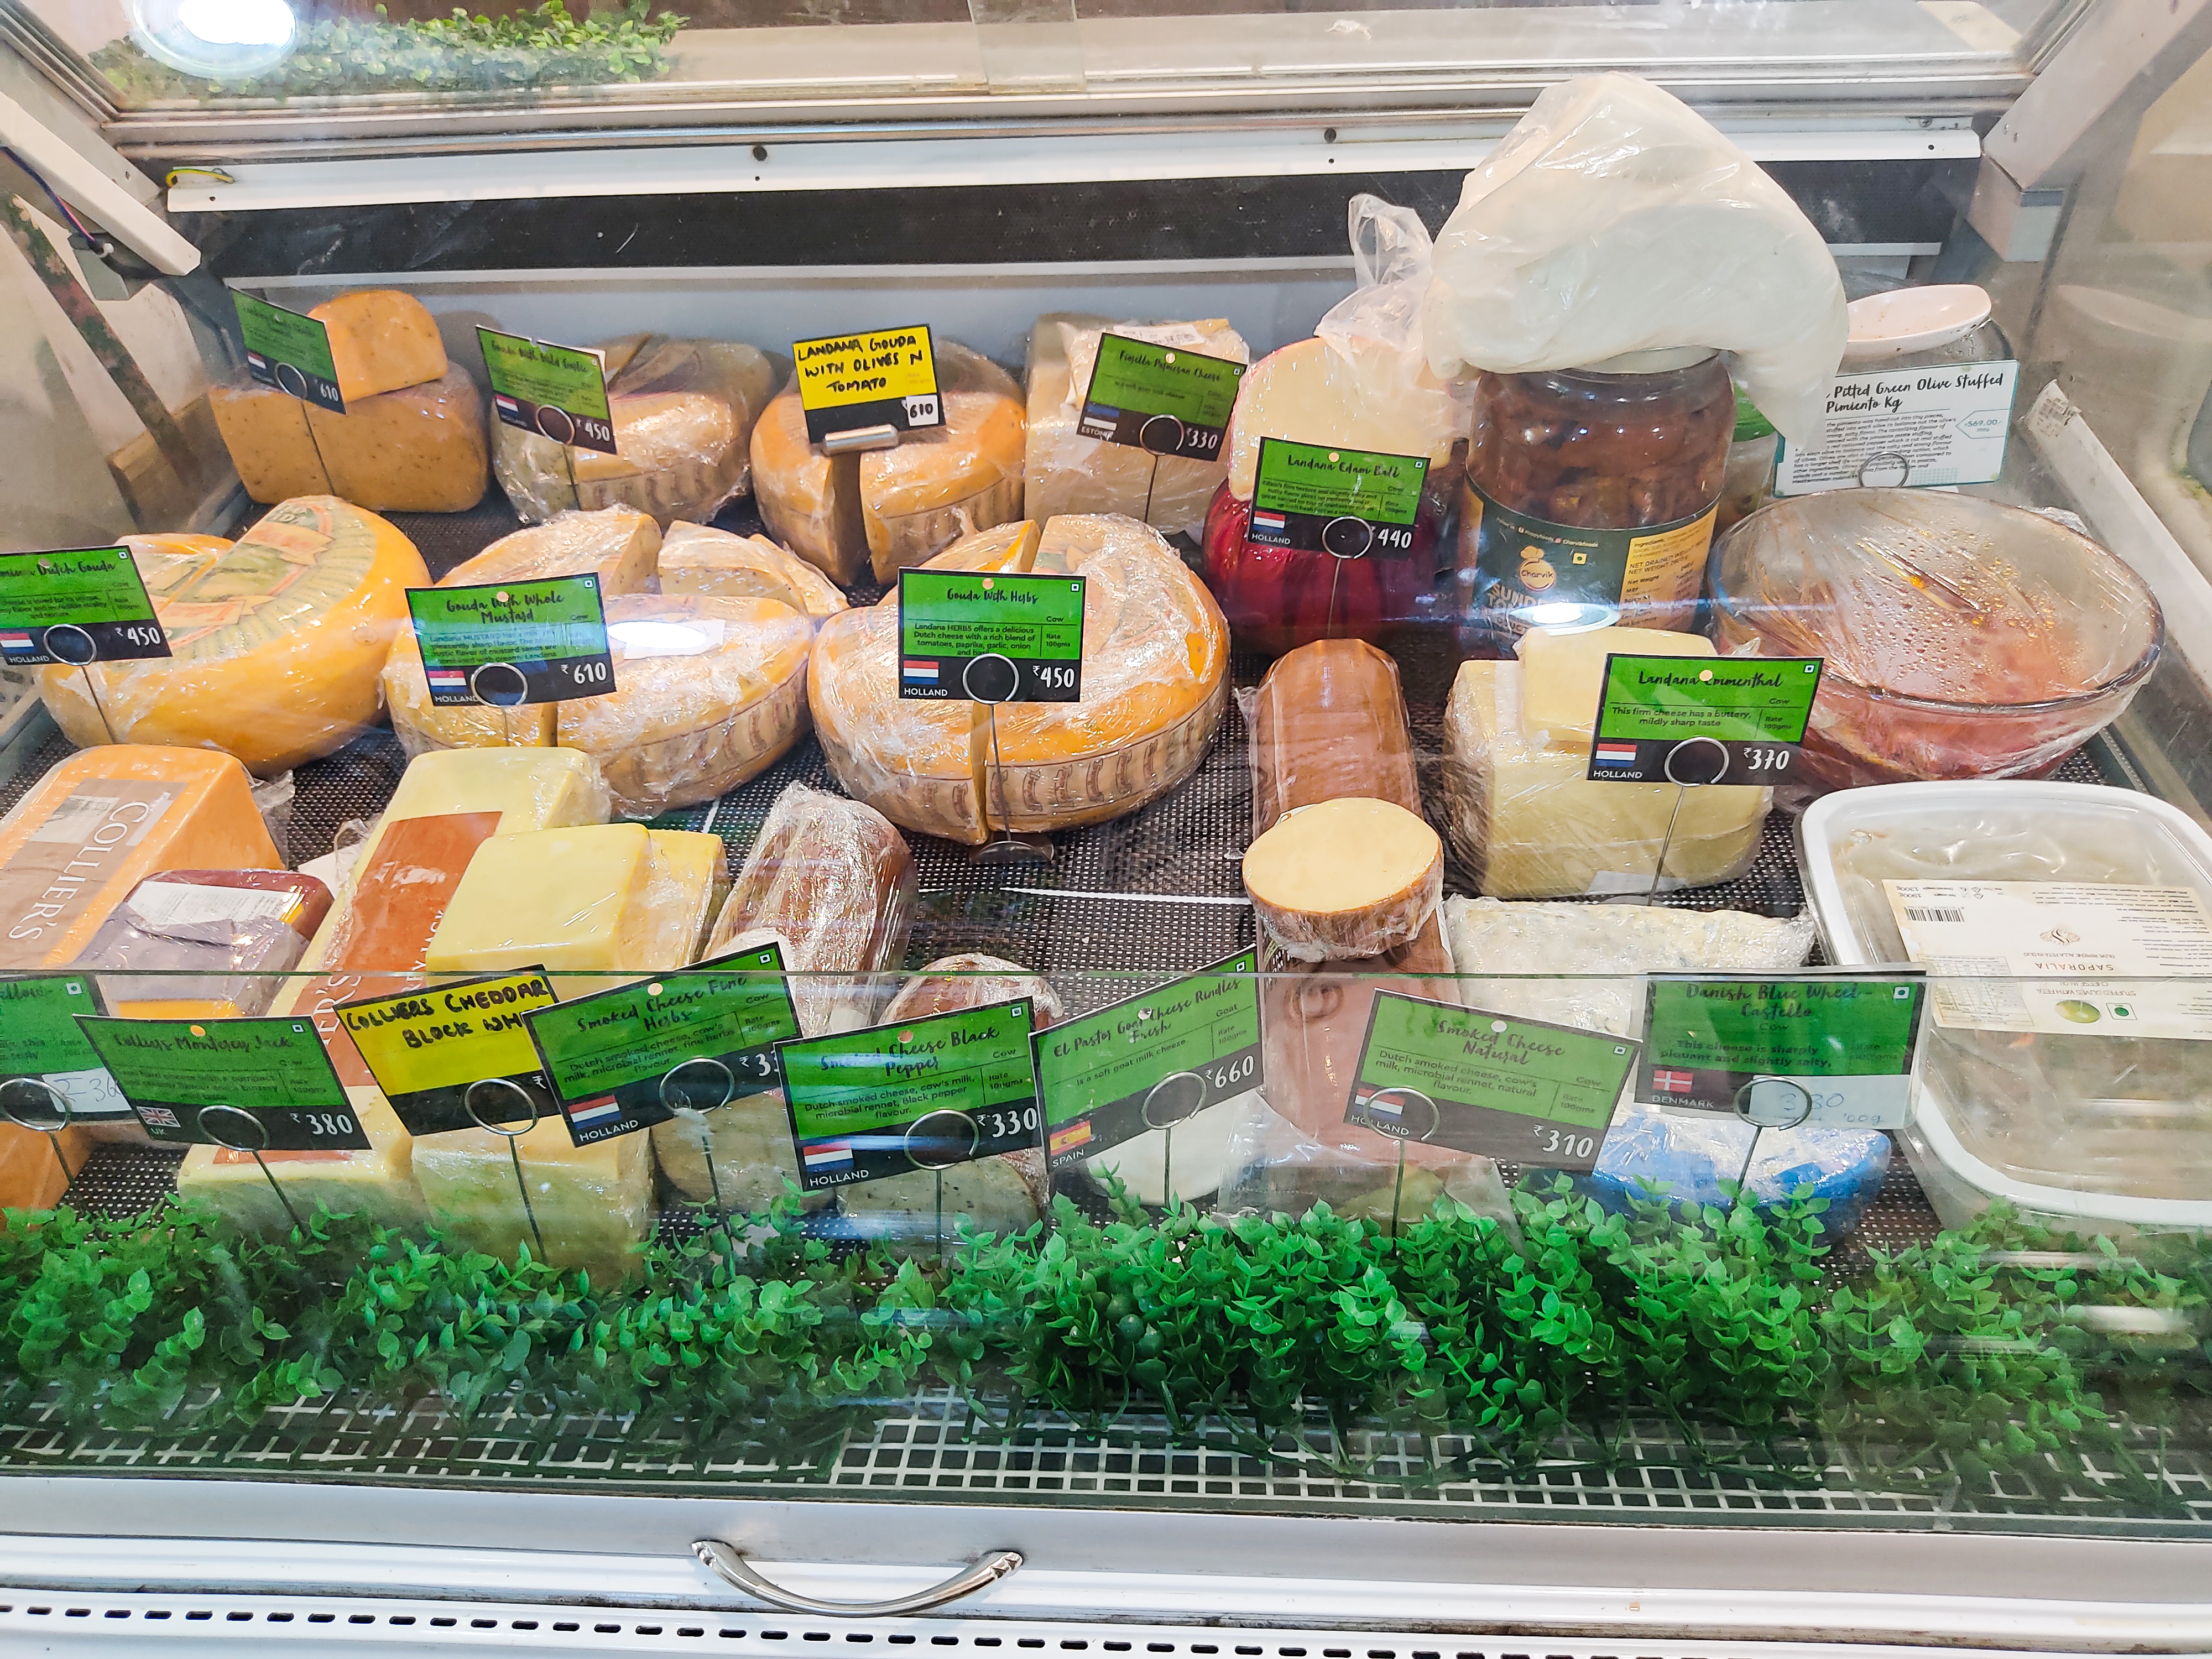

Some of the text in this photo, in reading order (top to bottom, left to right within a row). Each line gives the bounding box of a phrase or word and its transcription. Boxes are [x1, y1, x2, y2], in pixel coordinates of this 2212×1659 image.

[798, 336, 916, 361] LANDANA GOUDA
[805, 350, 922, 377] WITH OLIVES N
[826, 377, 886, 393] TOMATO
[1834, 373, 2004, 399] Pitted Green Olive Stuffed
[910, 403, 933, 418] 610
[1826, 396, 1903, 414] Pimiento Kg
[1288, 455, 1336, 471] Landana
[1373, 466, 1400, 478] Ball
[1251, 533, 1291, 545] HOLLAND
[78, 560, 116, 574] Gouda
[1521, 570, 1554, 579] Charvik
[447, 598, 488, 613] Gouda
[524, 590, 565, 606] Whole
[947, 588, 981, 601] Gouda
[984, 589, 1008, 603] With
[917, 640, 954, 648] tomatoes,
[956, 641, 985, 650] paprika,
[987, 642, 1009, 650] garlic,
[1639, 671, 1700, 686] Landana
[435, 695, 479, 703] HOLLAND
[904, 687, 948, 697] HOLLAND
[1611, 707, 1631, 715] This
[1633, 707, 1651, 716] firm
[1714, 708, 1751, 719] buttery,
[1639, 718, 1668, 727] mildly
[1593, 770, 1642, 779] HOLLAND
[2034, 963, 2114, 971] SAPORALIA
[445, 979, 549, 1013] CHEDDAR
[745, 994, 769, 1004] Cow
[1686, 984, 1750, 1000] Danish
[577, 977, 747, 1032] Smoked Cheese Fine
[1216, 1004, 1238, 1017] Goat
[1218, 1025, 1235, 1036] Rate
[1759, 1022, 1789, 1031] Cow
[403, 1021, 473, 1048] BLOCK
[1437, 1020, 1566, 1057] Smoked Cheese
[889, 1039, 946, 1058] Cheese
[950, 1027, 1000, 1047] Black
[1156, 1039, 1186, 1055] cheese
[992, 1048, 1016, 1058] Cow
[1053, 1044, 1071, 1058] El
[1714, 1054, 1738, 1063] and
[1379, 1051, 1537, 1088] Dutch smoked cheese, cow's
[564, 1072, 590, 1083] milk,
[1375, 1059, 1537, 1097] milk, microbial natural
[1576, 1076, 1601, 1087] Cow
[1433, 1080, 1472, 1095] flavour.
[804, 1079, 949, 1112] Dutch smoked cheese, cow's
[1562, 1093, 1583, 1103] Rate
[1651, 1094, 1715, 1109] DENMARK
[816, 1092, 928, 1120] microbial Black
[578, 1119, 639, 1143] HOLLAND
[1052, 1149, 1086, 1167] SPAIN
[810, 1169, 869, 1187] HOLLAND
